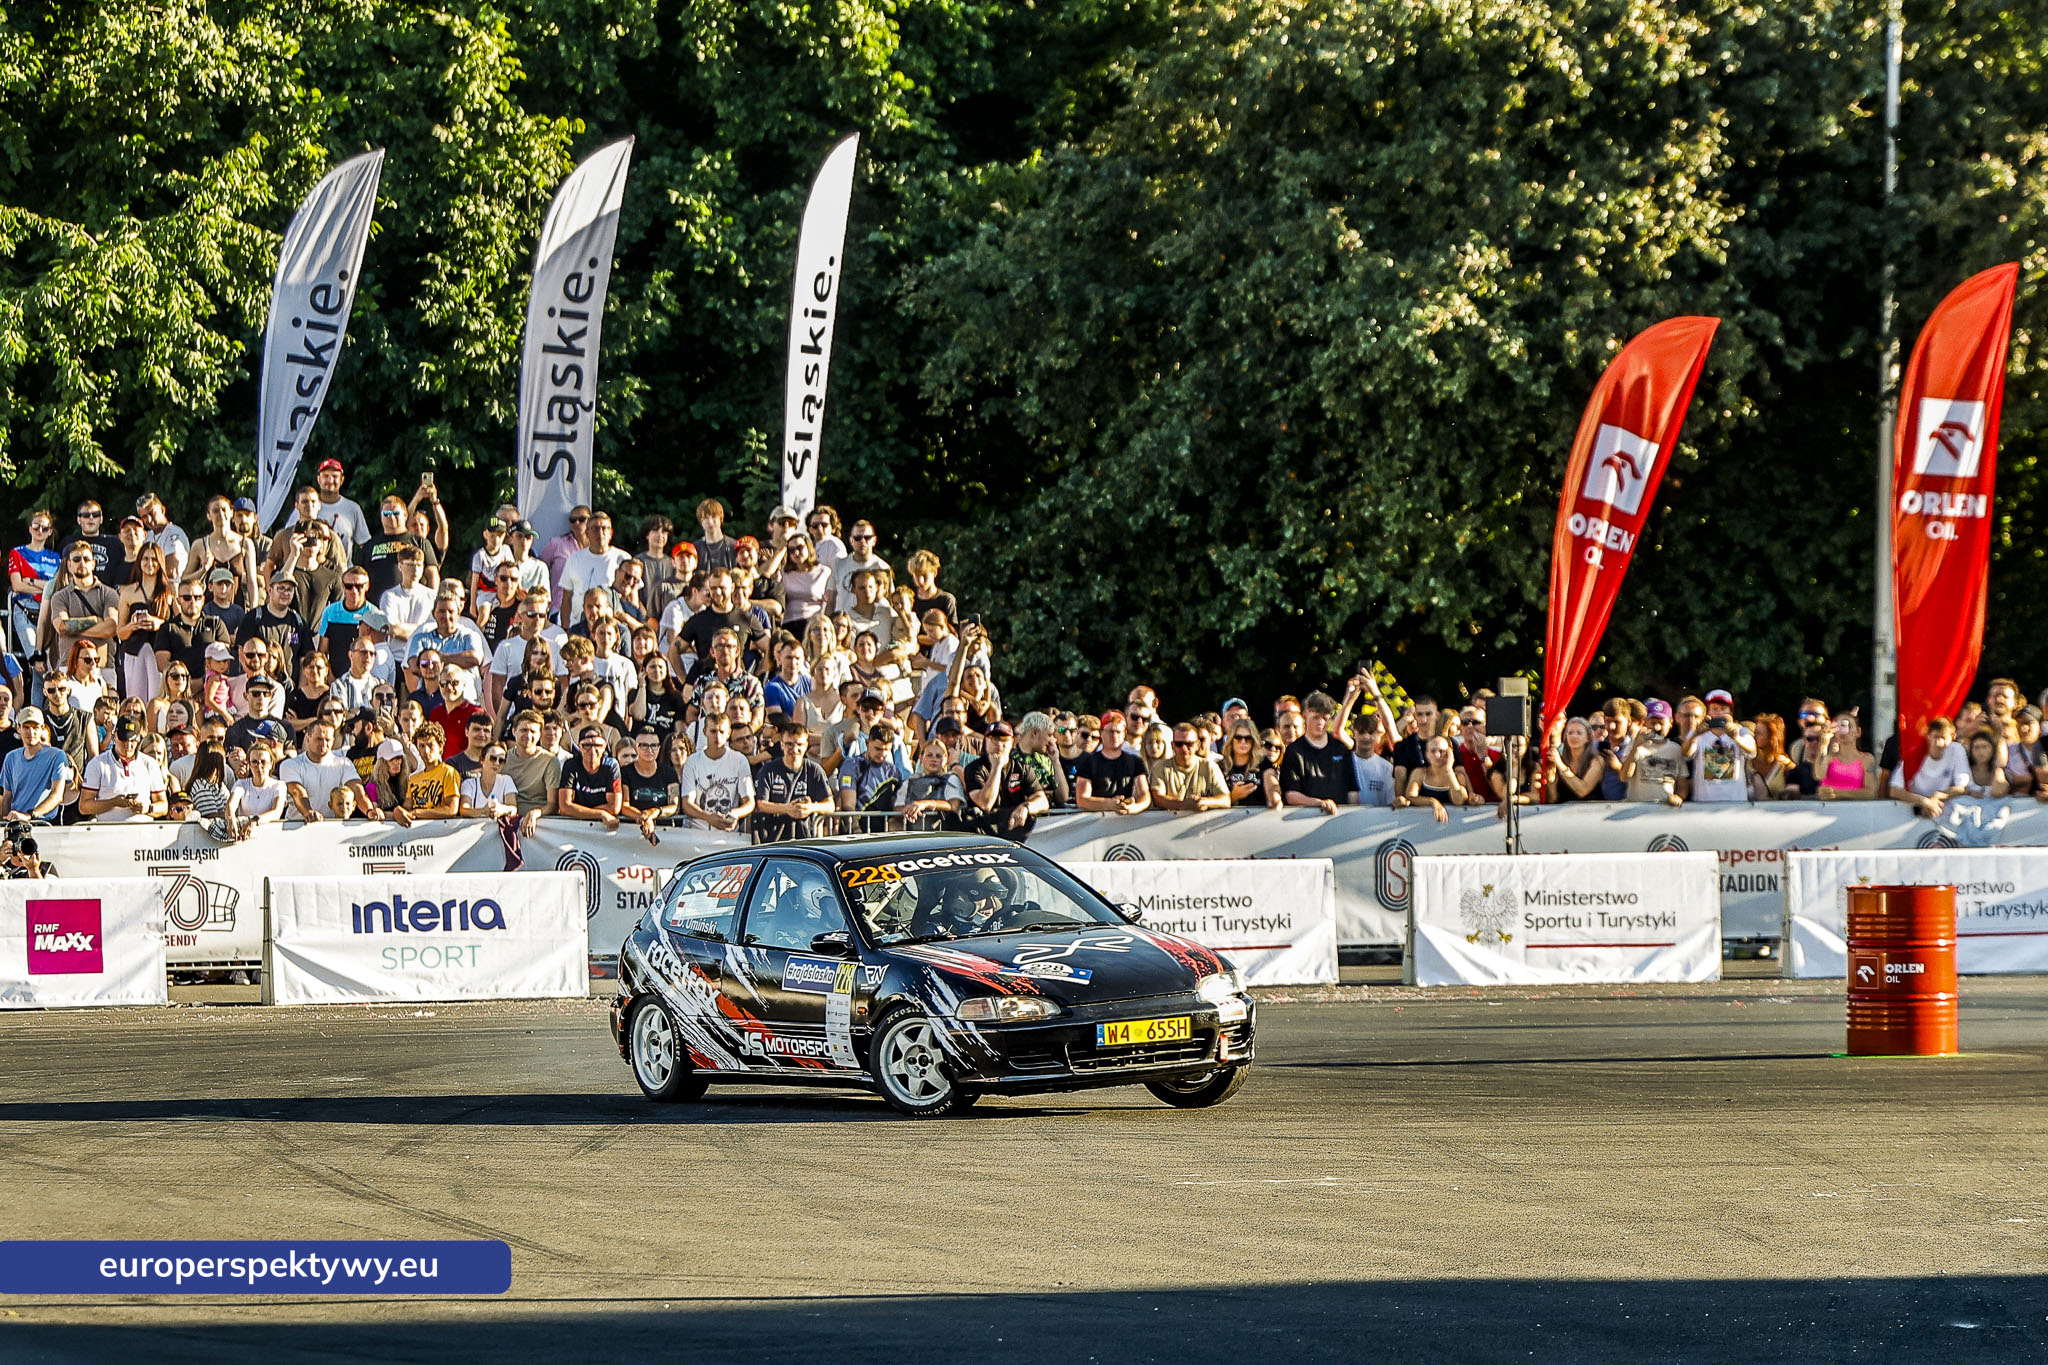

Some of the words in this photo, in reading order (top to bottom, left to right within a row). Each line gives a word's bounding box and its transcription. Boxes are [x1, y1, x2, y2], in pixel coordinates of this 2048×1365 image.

[266, 269, 349, 488] lskie.
[527, 256, 599, 484] Śląskie.
[788, 255, 836, 481] Śląskie.
[1900, 489, 1988, 519] ORLEN
[134, 848, 180, 862] STADION
[182, 845, 219, 865] ŚLĄSKI
[348, 844, 394, 859] STADION
[396, 841, 435, 861] ŚLĄSKI
[707, 865, 753, 900] 228
[841, 865, 902, 888] 228
[1720, 873, 1779, 893] TADION
[1137, 894, 1253, 911] Ministerstwo
[1524, 889, 1639, 907] Ministerstwo
[351, 894, 507, 934] interia
[1524, 912, 1582, 931] Sportu
[1587, 911, 1592, 928] i
[1599, 910, 1677, 931] Turystyki
[1974, 899, 2048, 921] Turystyk
[33, 923, 60, 934] RMF
[1202, 915, 1208, 932] i
[1211, 912, 1292, 934] Turystyki
[381, 944, 482, 971] SPORT
[1884, 963, 1925, 974] ORLEN
[1885, 975, 1901, 984] OIL
[1107, 1024, 1130, 1044] W4
[1146, 1018, 1188, 1041] 655H
[738, 1031, 764, 1057] JS
[764, 1036, 834, 1057] MOTORSPO
